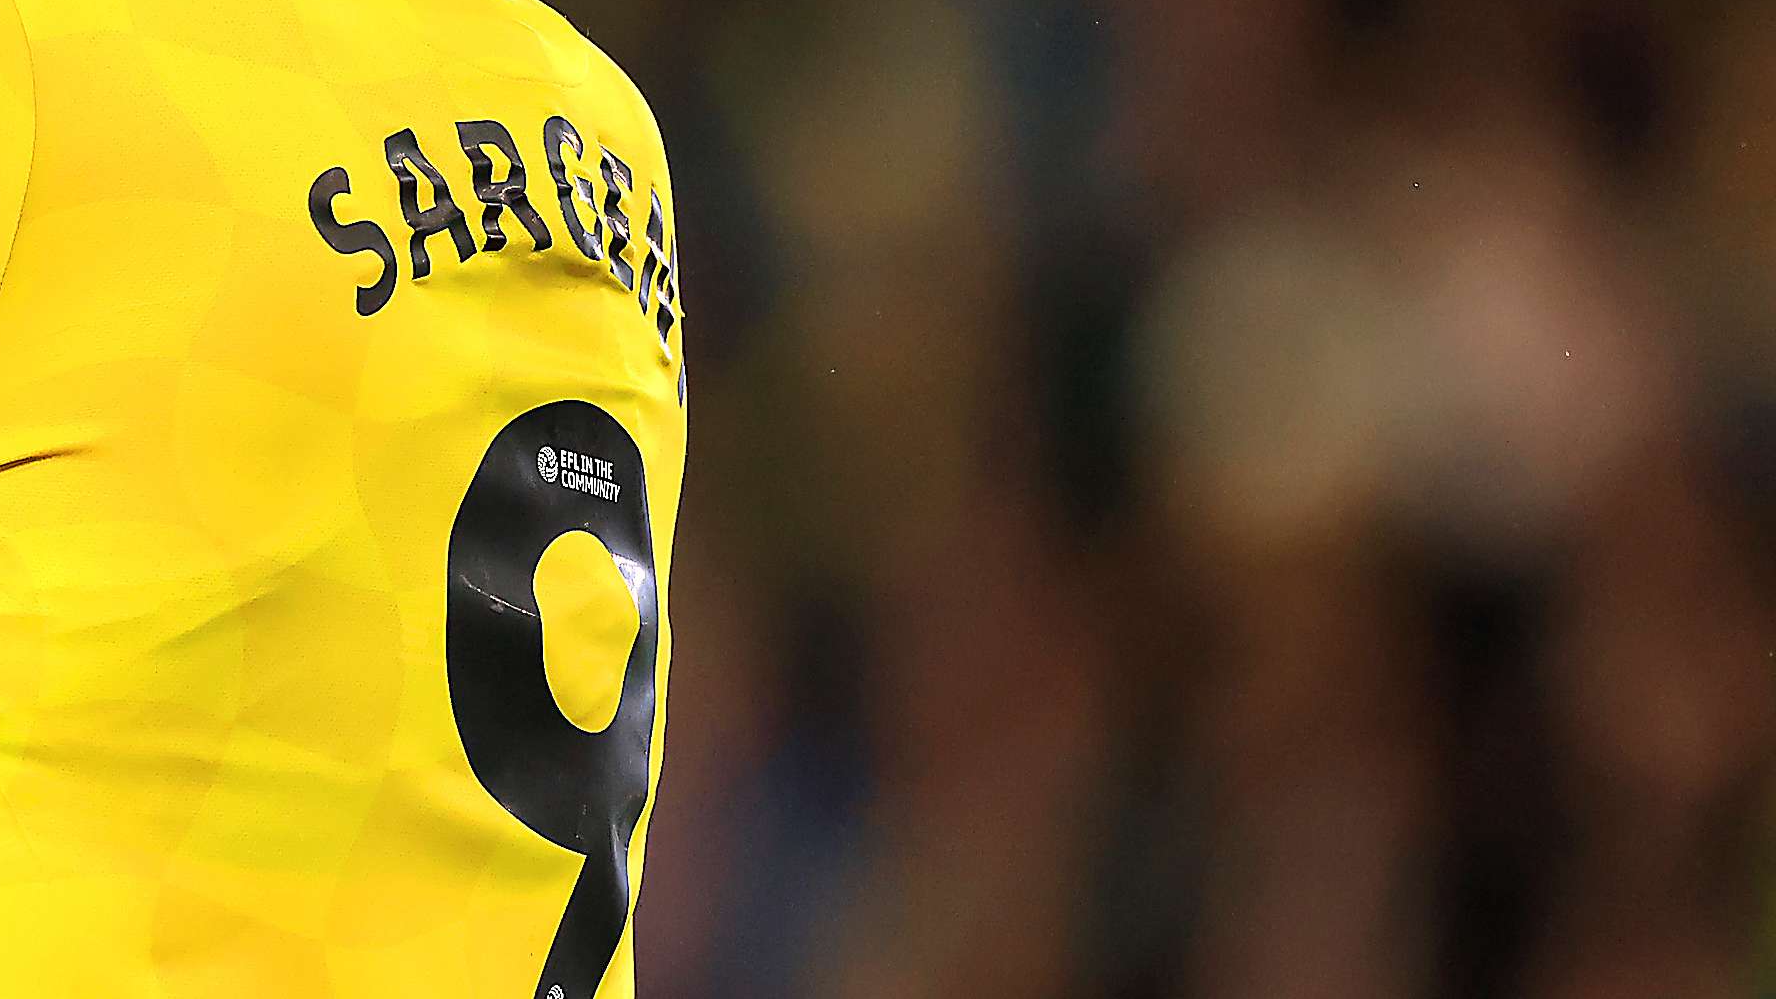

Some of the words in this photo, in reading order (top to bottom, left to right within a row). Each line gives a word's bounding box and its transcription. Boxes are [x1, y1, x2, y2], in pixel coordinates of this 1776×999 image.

[308, 116, 686, 408] SARGEN
[560, 449, 579, 471] EFL
[581, 454, 594, 475] IN
[594, 458, 613, 480] THE
[561, 469, 621, 503] COMMUNITY
[446, 400, 658, 999] 9
